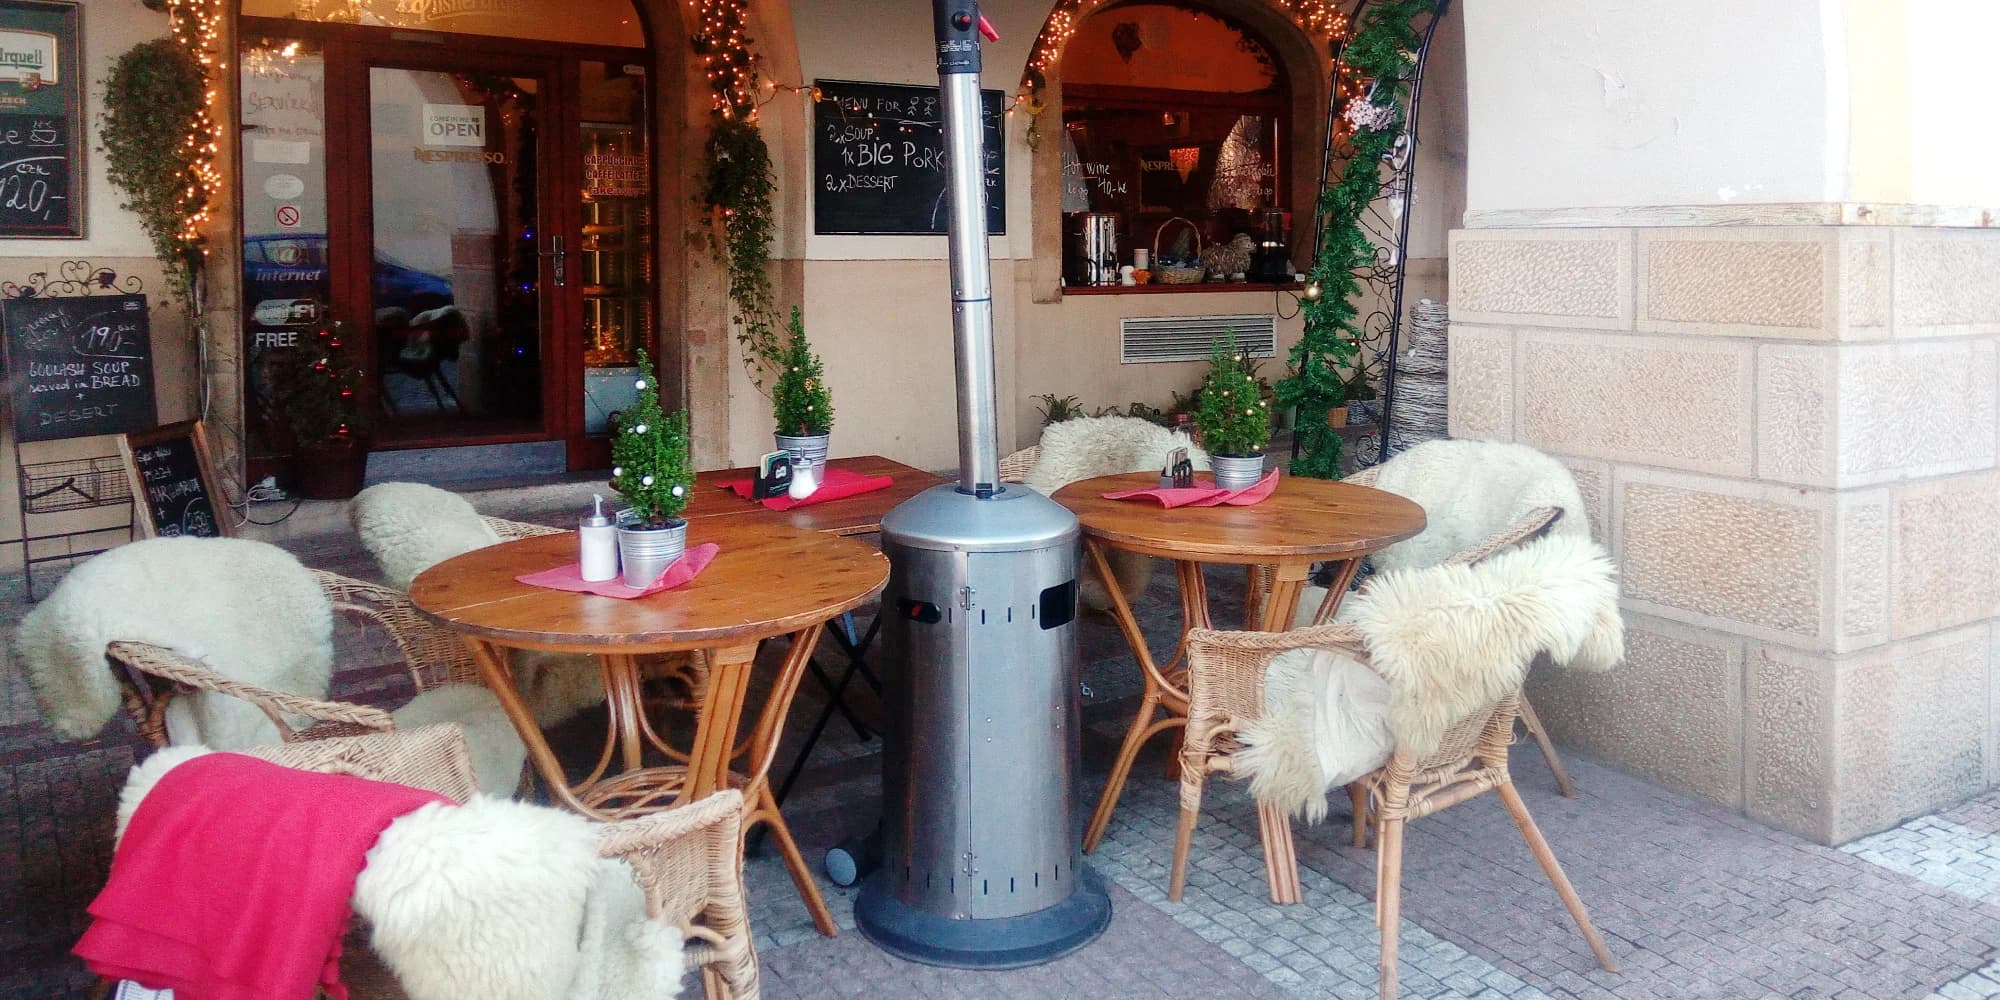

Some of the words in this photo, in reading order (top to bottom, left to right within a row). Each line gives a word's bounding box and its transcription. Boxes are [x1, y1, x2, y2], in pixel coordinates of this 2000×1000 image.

[0, 48, 42, 69] rquell
[877, 97, 901, 112] FOR
[430, 122, 481, 137] OPEN
[857, 142, 894, 167] BIG
[255, 268, 321, 281] internet
[255, 332, 298, 347] FREE
[92, 361, 130, 375] SOUP
[90, 375, 140, 389] BREAD
[40, 403, 118, 426] DESERT
